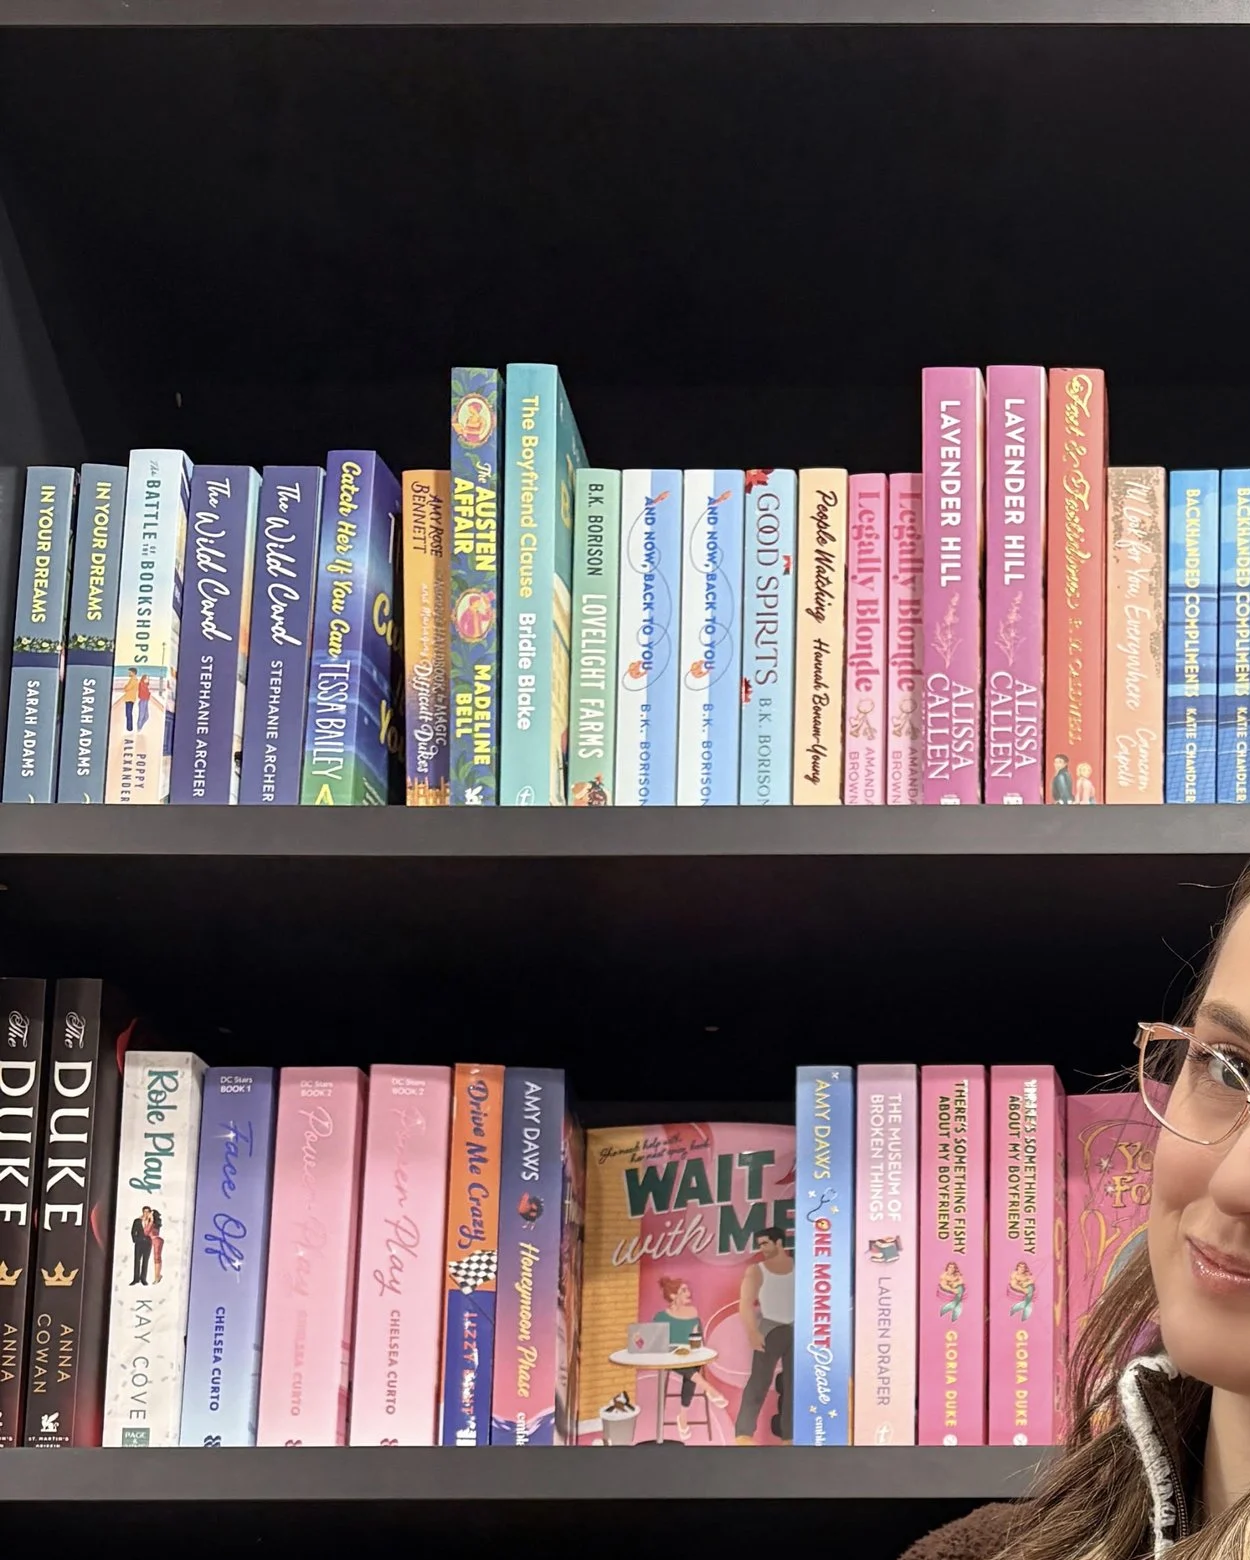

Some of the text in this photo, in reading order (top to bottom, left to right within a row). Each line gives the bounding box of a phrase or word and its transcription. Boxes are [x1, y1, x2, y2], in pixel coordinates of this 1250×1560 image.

[31, 485, 55, 624] IN YOUR DREAMS
[453, 479, 474, 554] AFFAIR
[474, 462, 496, 571] The AUSTEN
[519, 396, 540, 599] The Boyfriend Clause
[1003, 399, 1026, 585] LAVENDER HILL
[194, 478, 232, 641] The Wild Card
[756, 492, 780, 685] GOOD SPIRITS
[21, 681, 40, 777] SARAH ADAMS
[192, 655, 213, 798] STEPHANIE ARCHER
[516, 612, 536, 730] Bridie Blake
[577, 594, 607, 759] LOVELIGHT FARMS
[989, 670, 1013, 780] CALLEN
[1014, 680, 1037, 770] ALISSA
[43, 1061, 92, 1231] DUKE
[129, 1069, 179, 1194] Role Play
[625, 1151, 777, 1218] WAIT
[613, 1214, 717, 1267] with
[209, 1306, 226, 1412] CHELSEA CURTO
[875, 1276, 892, 1406] LAUREN DRAPER
